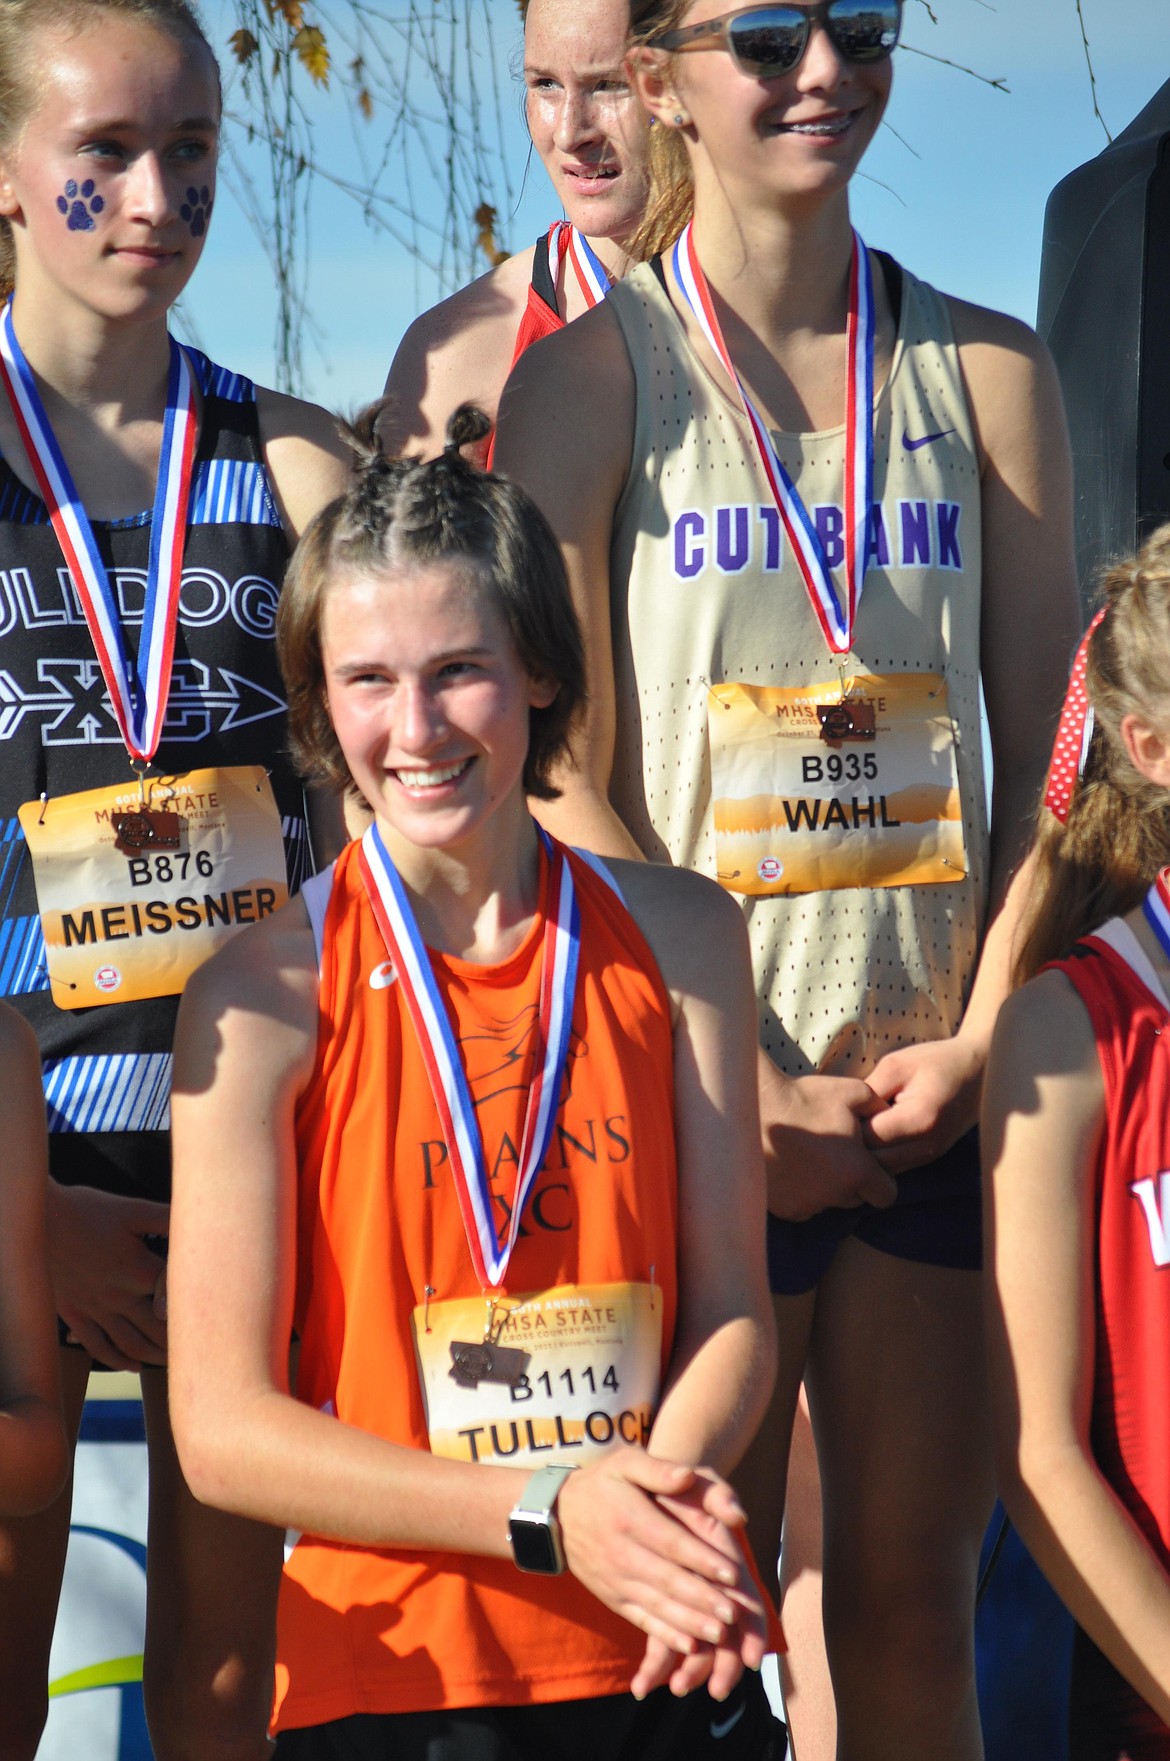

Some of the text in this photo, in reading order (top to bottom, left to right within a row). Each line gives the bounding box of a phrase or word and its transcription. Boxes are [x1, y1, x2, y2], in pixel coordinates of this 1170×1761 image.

[670, 503, 783, 582] CUT
[776, 704, 818, 719] MHS
[801, 752, 878, 783] B935
[782, 795, 900, 832] WAHL
[128, 850, 214, 887] B876
[62, 888, 277, 947] MEISSNER
[556, 1308, 617, 1328] STATE
[509, 1365, 620, 1403] B1114
